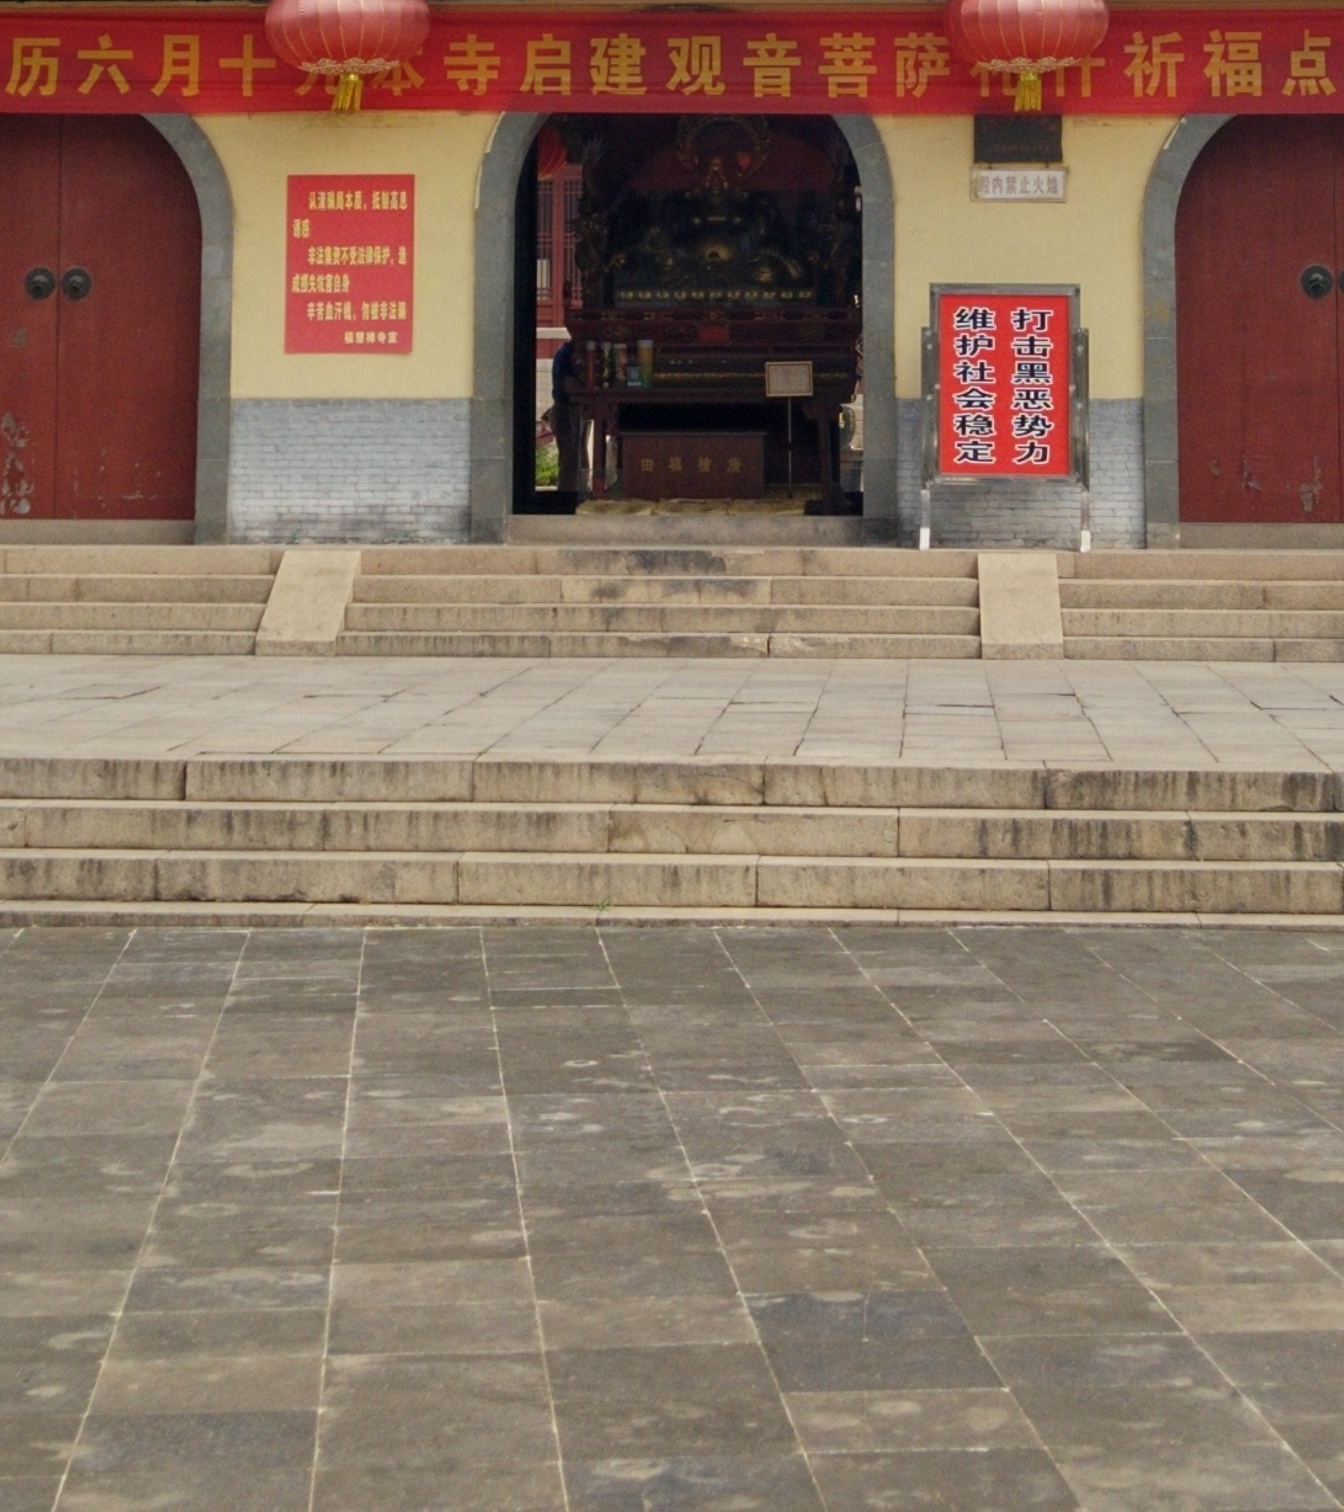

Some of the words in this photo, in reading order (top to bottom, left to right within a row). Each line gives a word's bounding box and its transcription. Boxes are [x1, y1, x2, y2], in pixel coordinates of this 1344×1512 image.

[952, 307, 996, 465] 维护社会稳定
[1010, 307, 1054, 465] 打击黑恶势力
